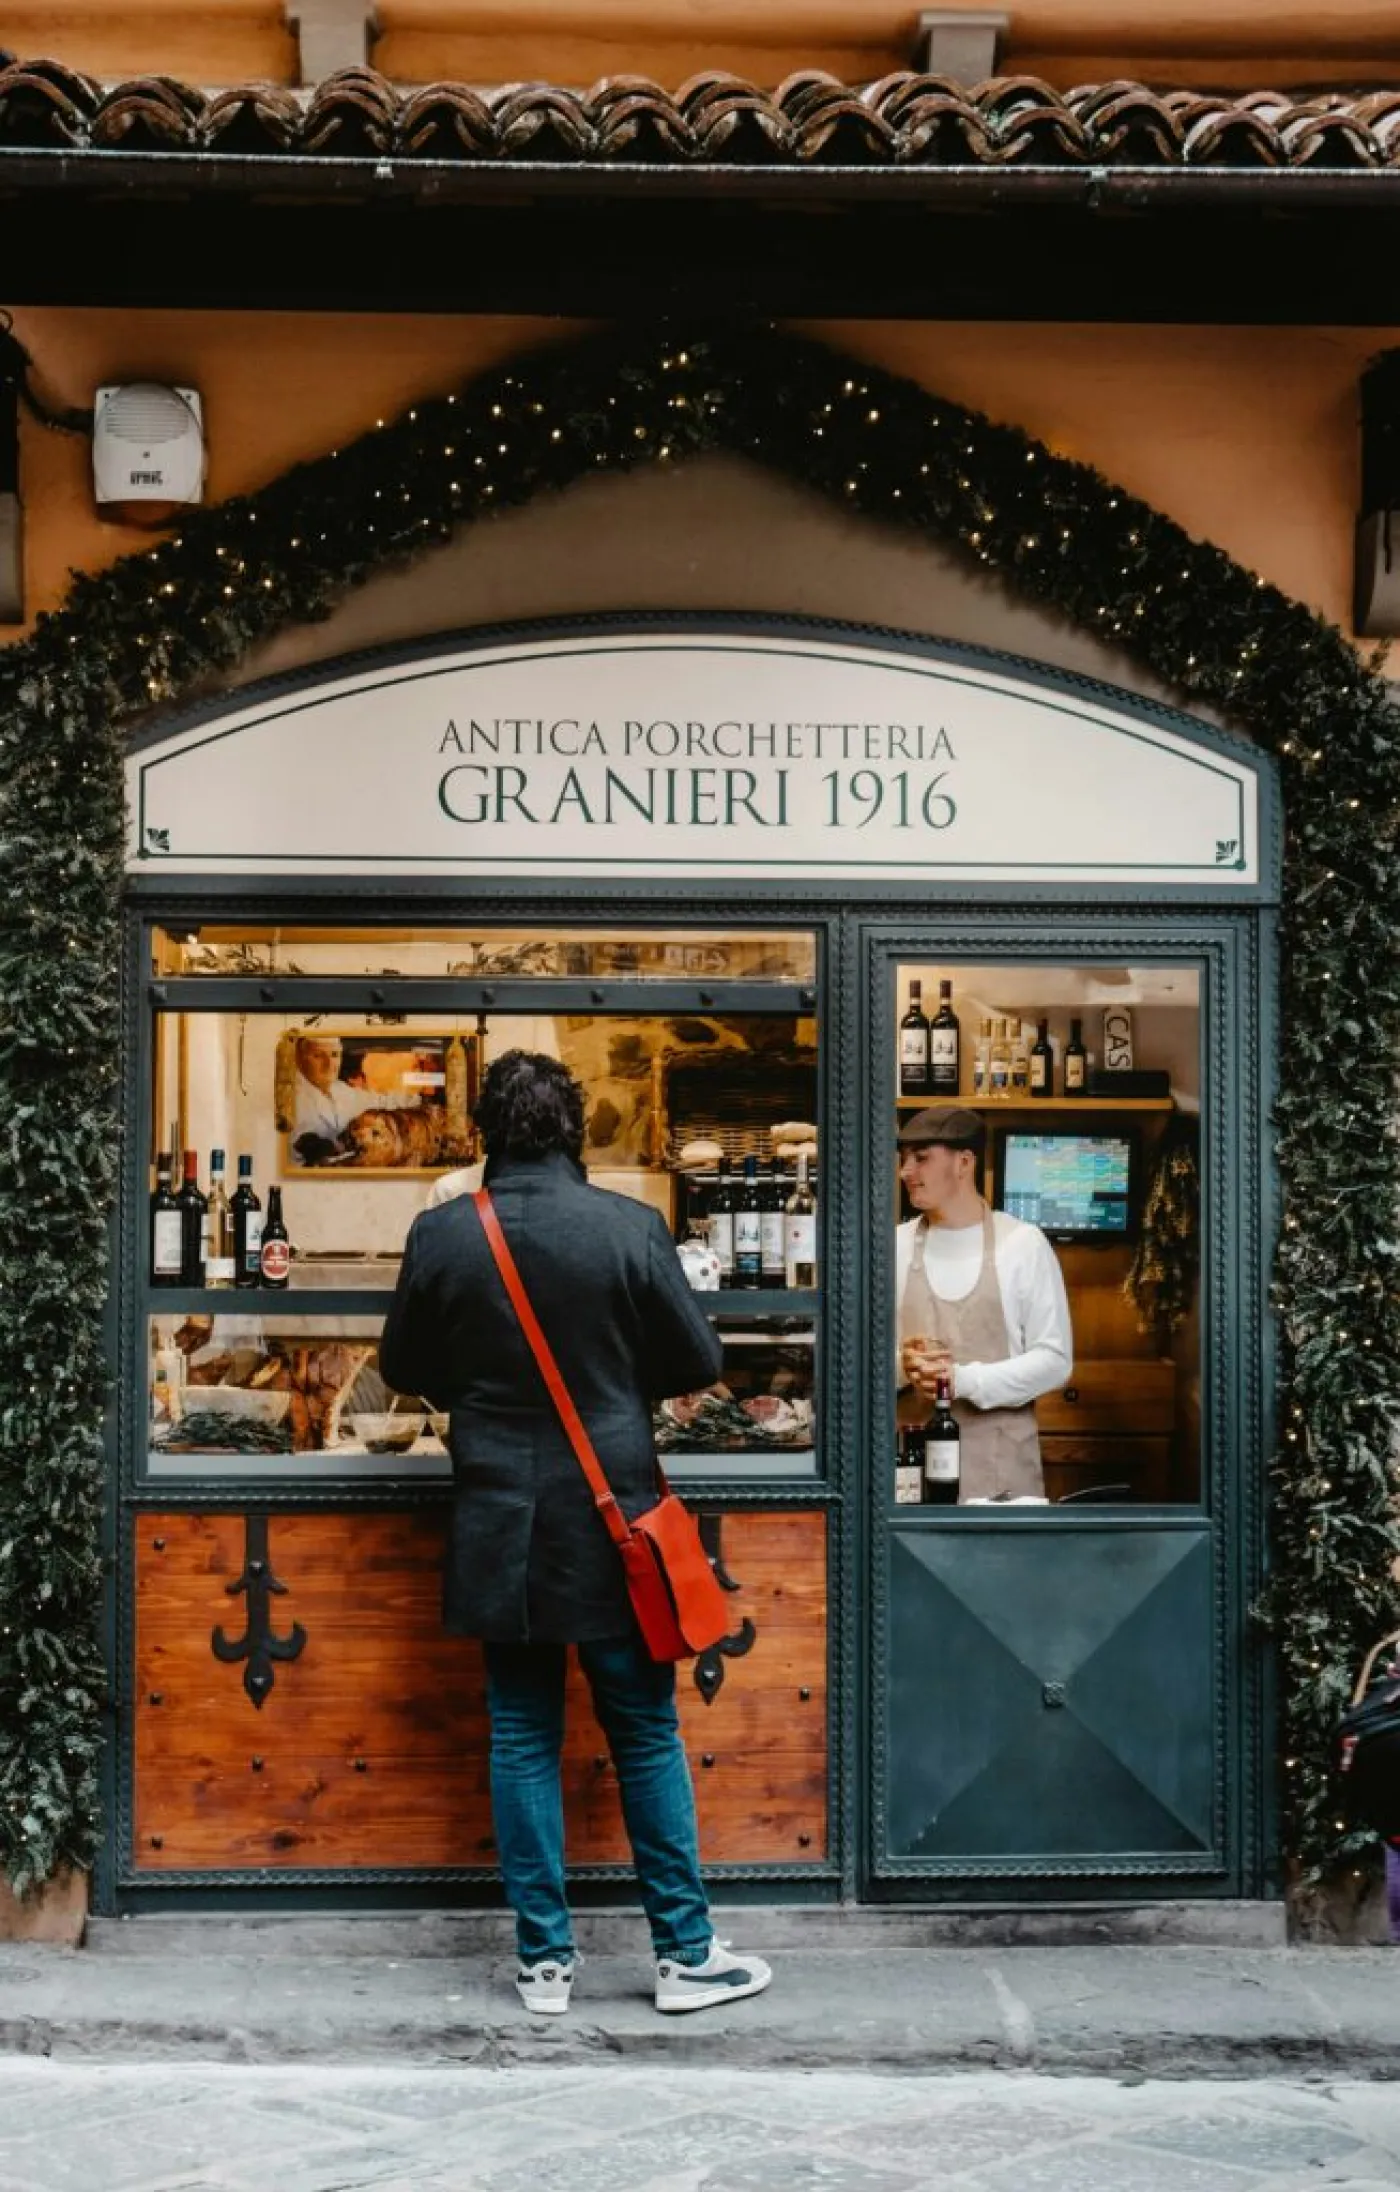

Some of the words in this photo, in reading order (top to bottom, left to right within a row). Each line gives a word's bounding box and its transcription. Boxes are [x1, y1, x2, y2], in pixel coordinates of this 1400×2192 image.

[438, 719, 608, 755] ANTICA
[623, 720, 957, 760] PORCHETTERIA
[438, 764, 793, 827] GRANIERI
[821, 769, 958, 829] 1916
